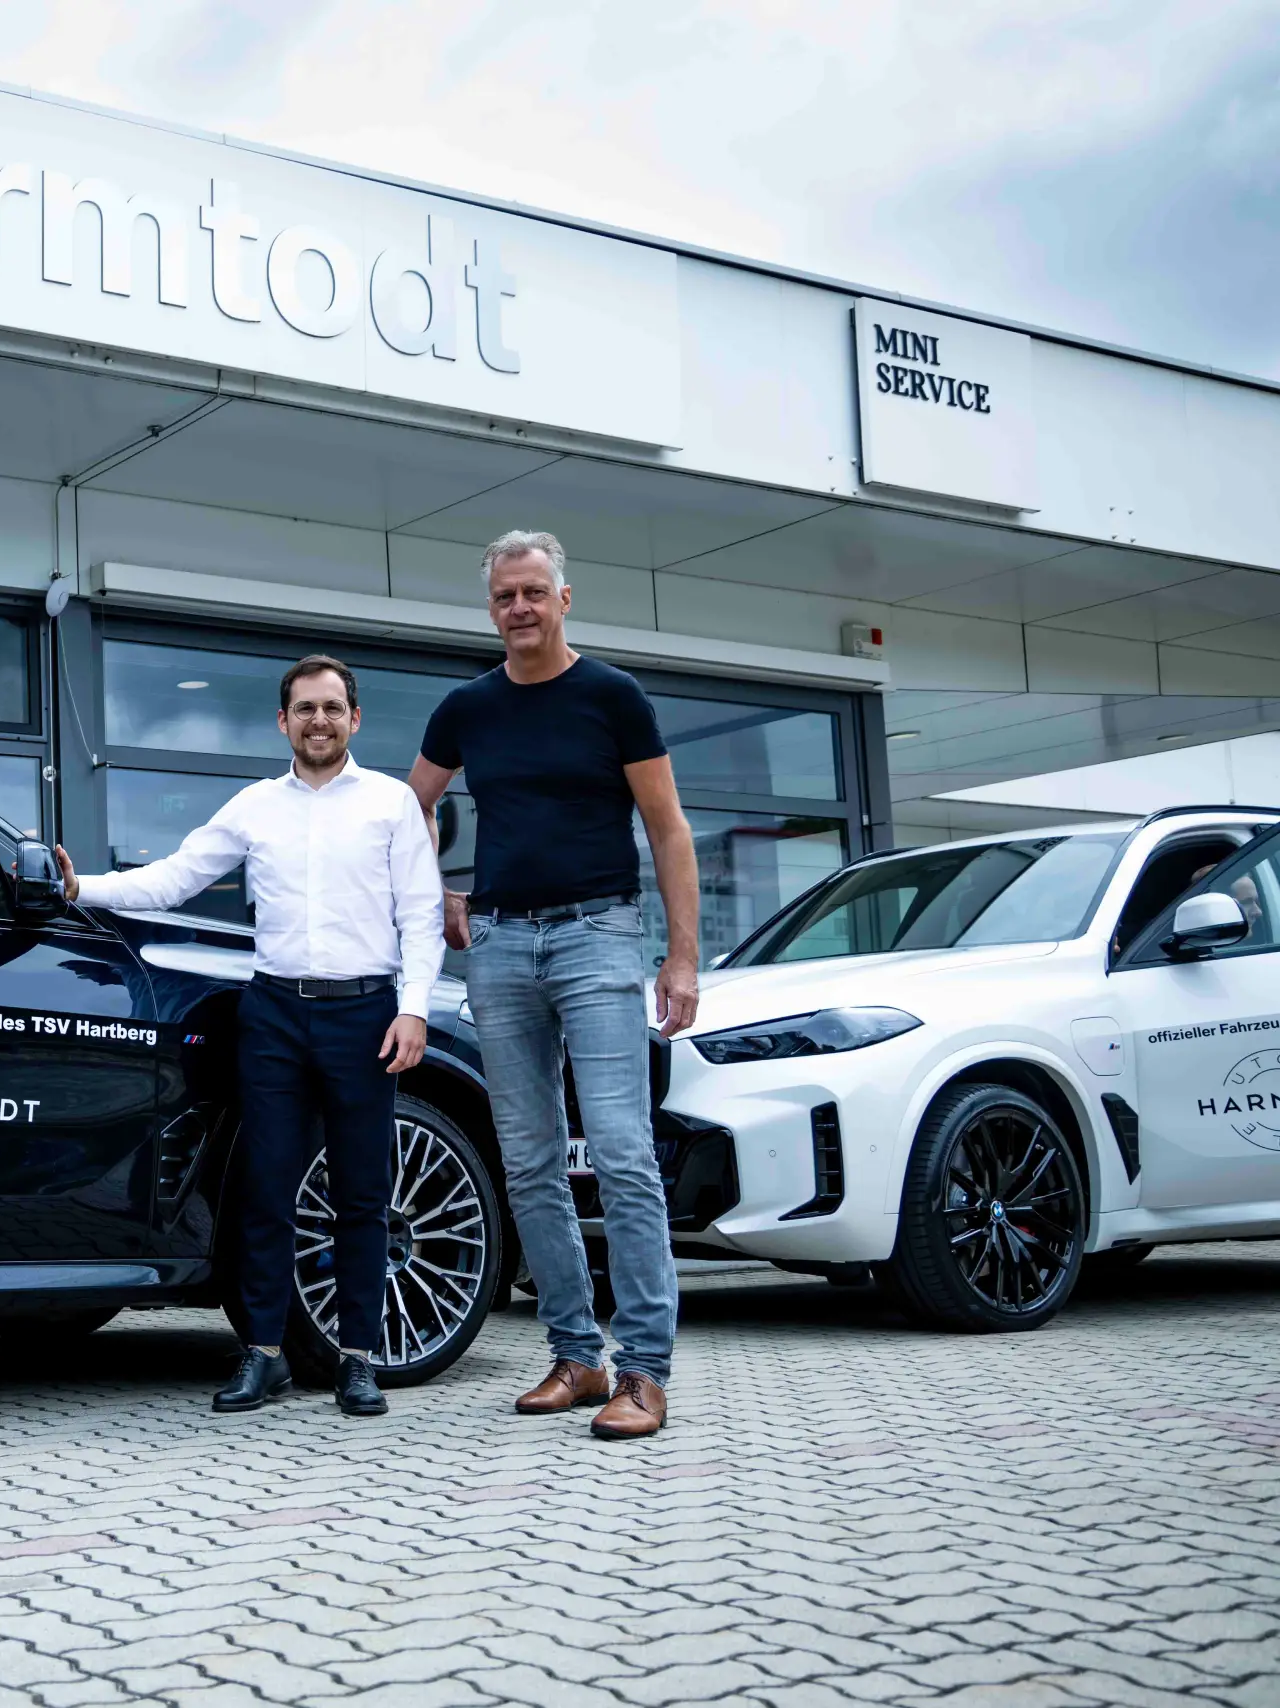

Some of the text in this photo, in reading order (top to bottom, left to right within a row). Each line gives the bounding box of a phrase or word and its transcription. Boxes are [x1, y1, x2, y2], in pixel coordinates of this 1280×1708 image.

[873, 323, 941, 366] MINI
[876, 362, 991, 414] SERVICE
[31, 1015, 71, 1035] TSV
[76, 1020, 158, 1046] Hartberg
[1148, 1027, 1217, 1044] offizieller
